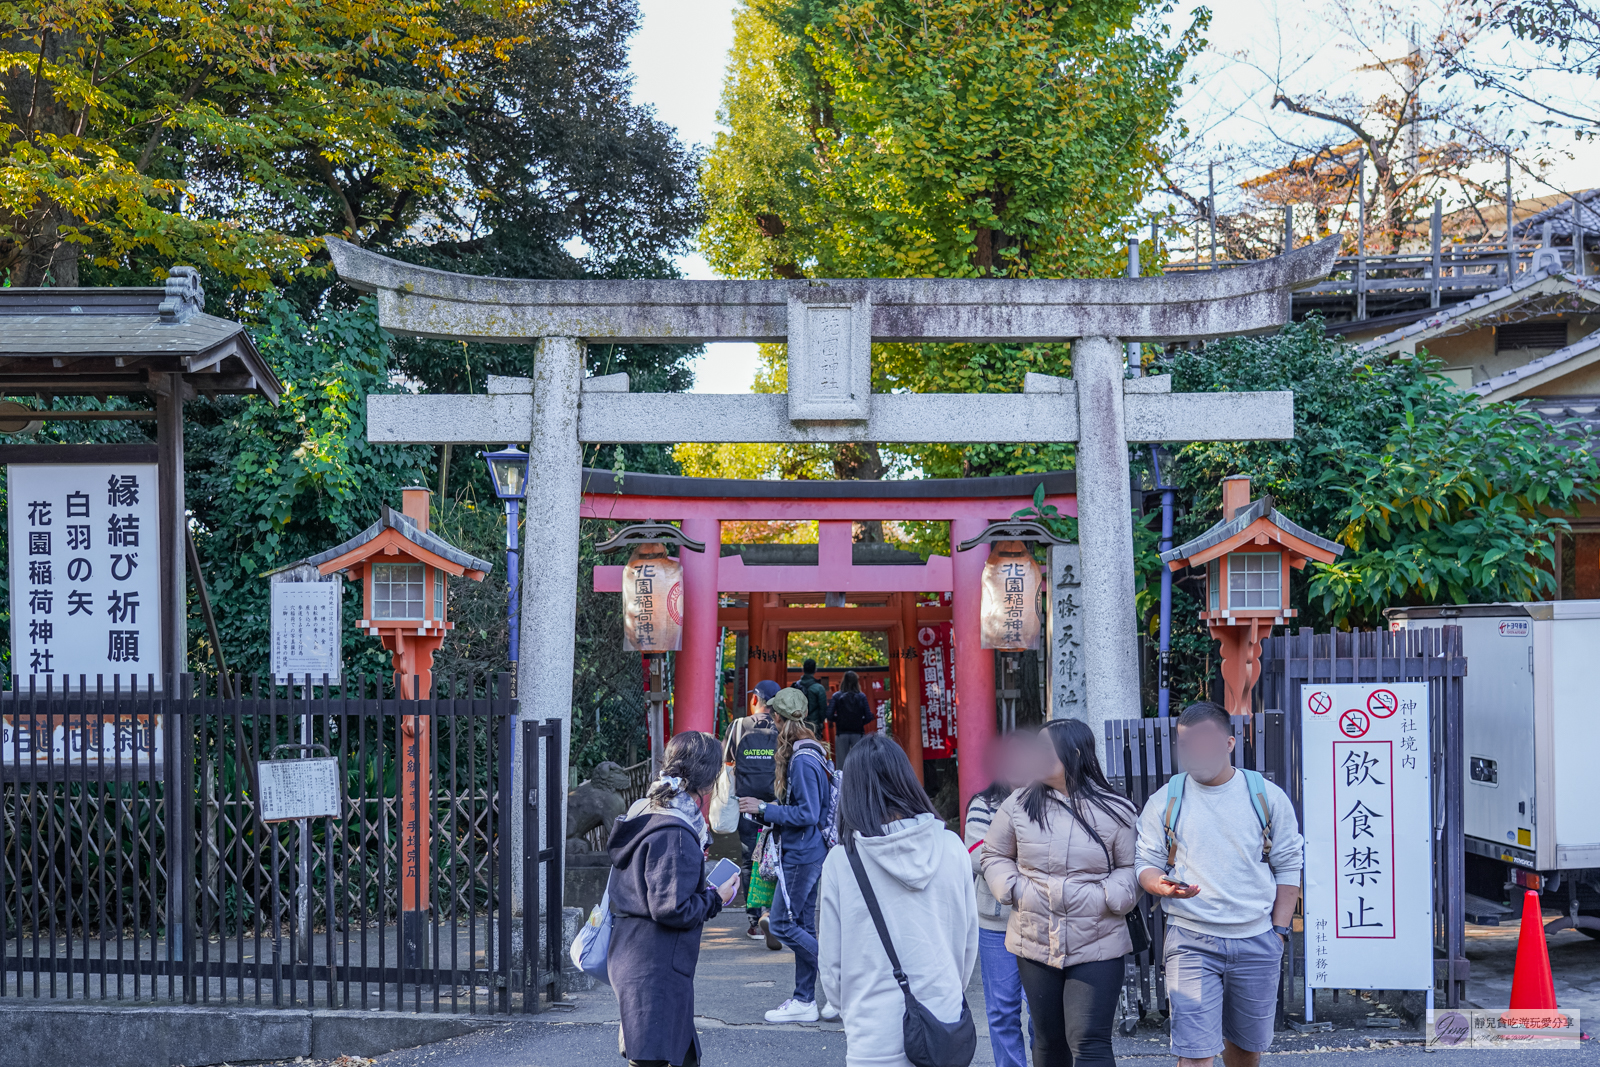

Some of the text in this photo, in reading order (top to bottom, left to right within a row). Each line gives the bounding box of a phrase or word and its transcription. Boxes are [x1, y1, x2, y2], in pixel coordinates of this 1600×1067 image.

[28, 501, 54, 674] 花園稲荷神社
[66, 491, 93, 617] 白羽の矢
[107, 474, 140, 663] 縁結び祈願
[634, 564, 657, 646] 花園稲荷神社
[1001, 563, 1025, 643] 花園稲荷神社
[921, 647, 946, 750] 花園稲荷神社
[1399, 698, 1418, 770] 神社境内
[743, 748, 775, 756] GATEONE
[1341, 750, 1386, 931] 飲食禁止
[1314, 917, 1329, 984] 神社社務所
